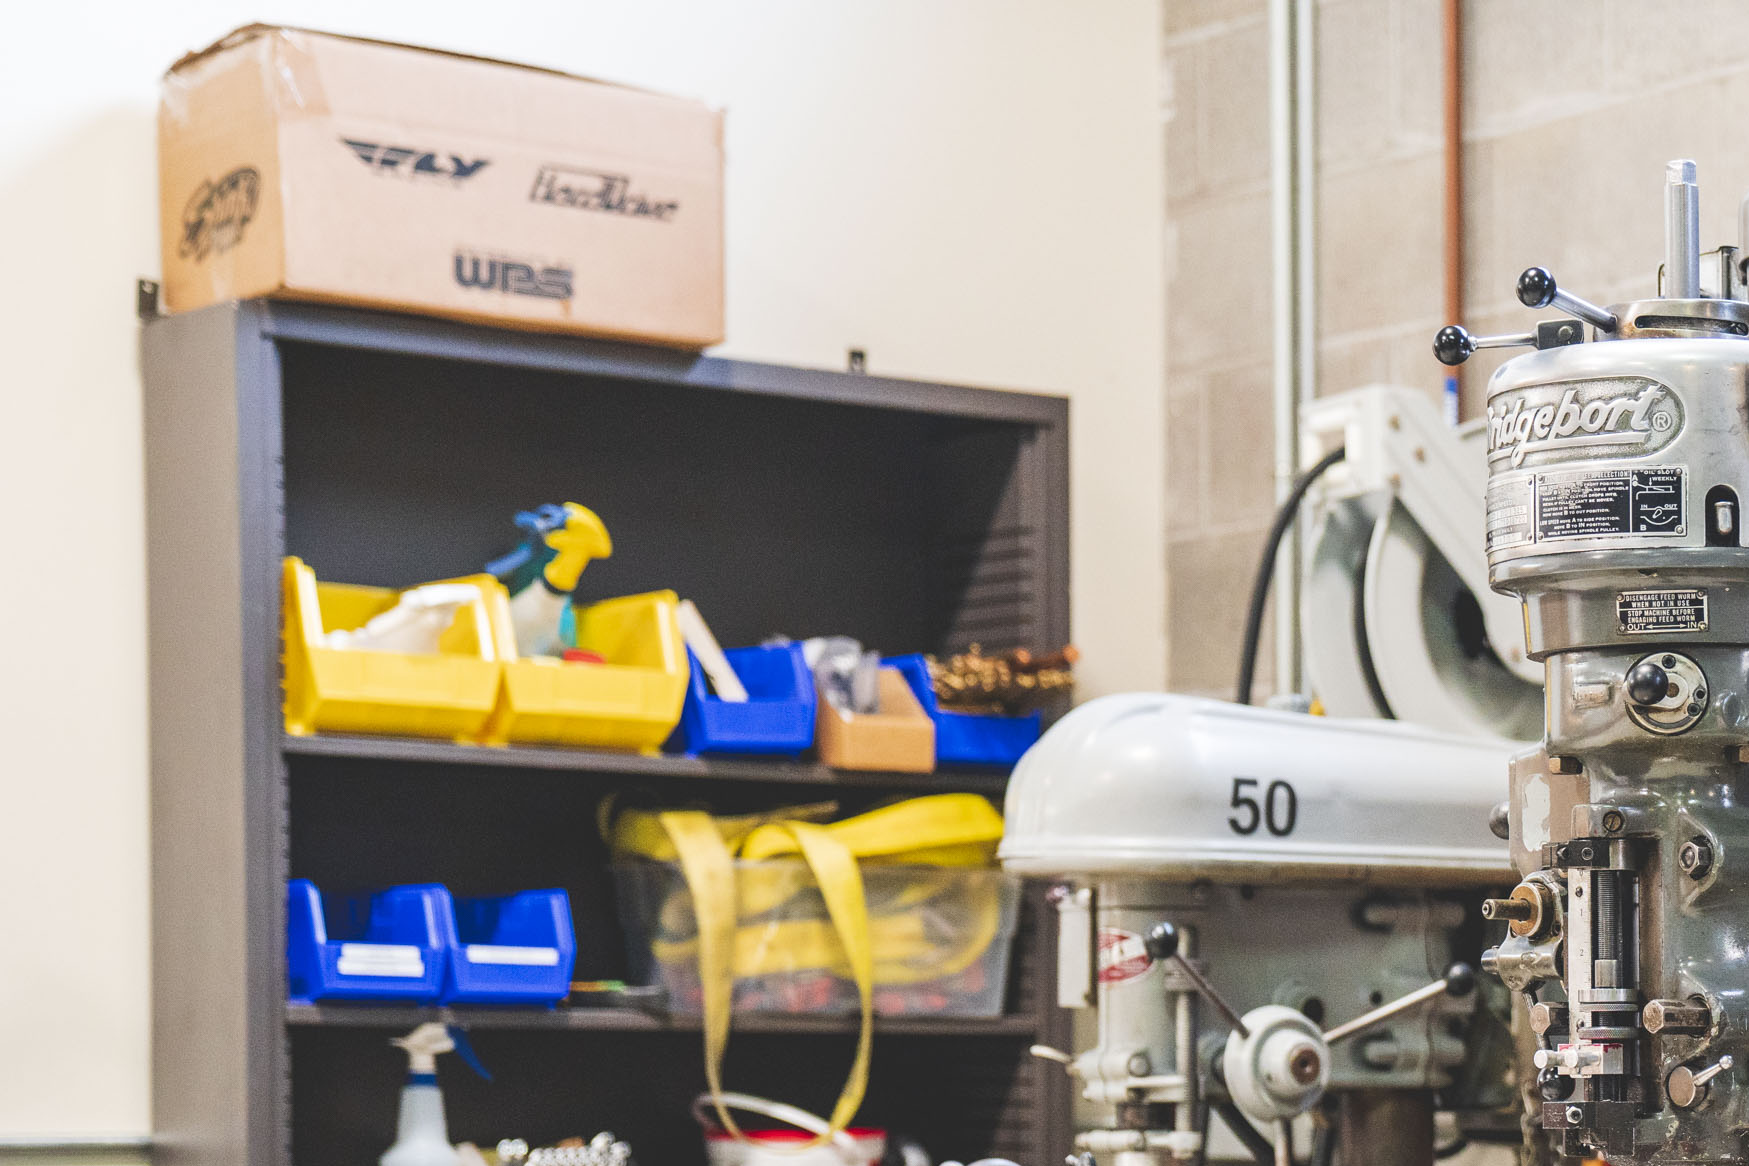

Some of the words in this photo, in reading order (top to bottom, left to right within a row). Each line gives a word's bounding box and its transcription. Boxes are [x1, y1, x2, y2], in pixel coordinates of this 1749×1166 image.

[453, 251, 575, 300] WPS
[1625, 594, 1658, 602] DISENGAGE
[1628, 616, 1657, 624] ENGAGING
[1627, 623, 1645, 631] OUT
[1229, 778, 1297, 836] 50
